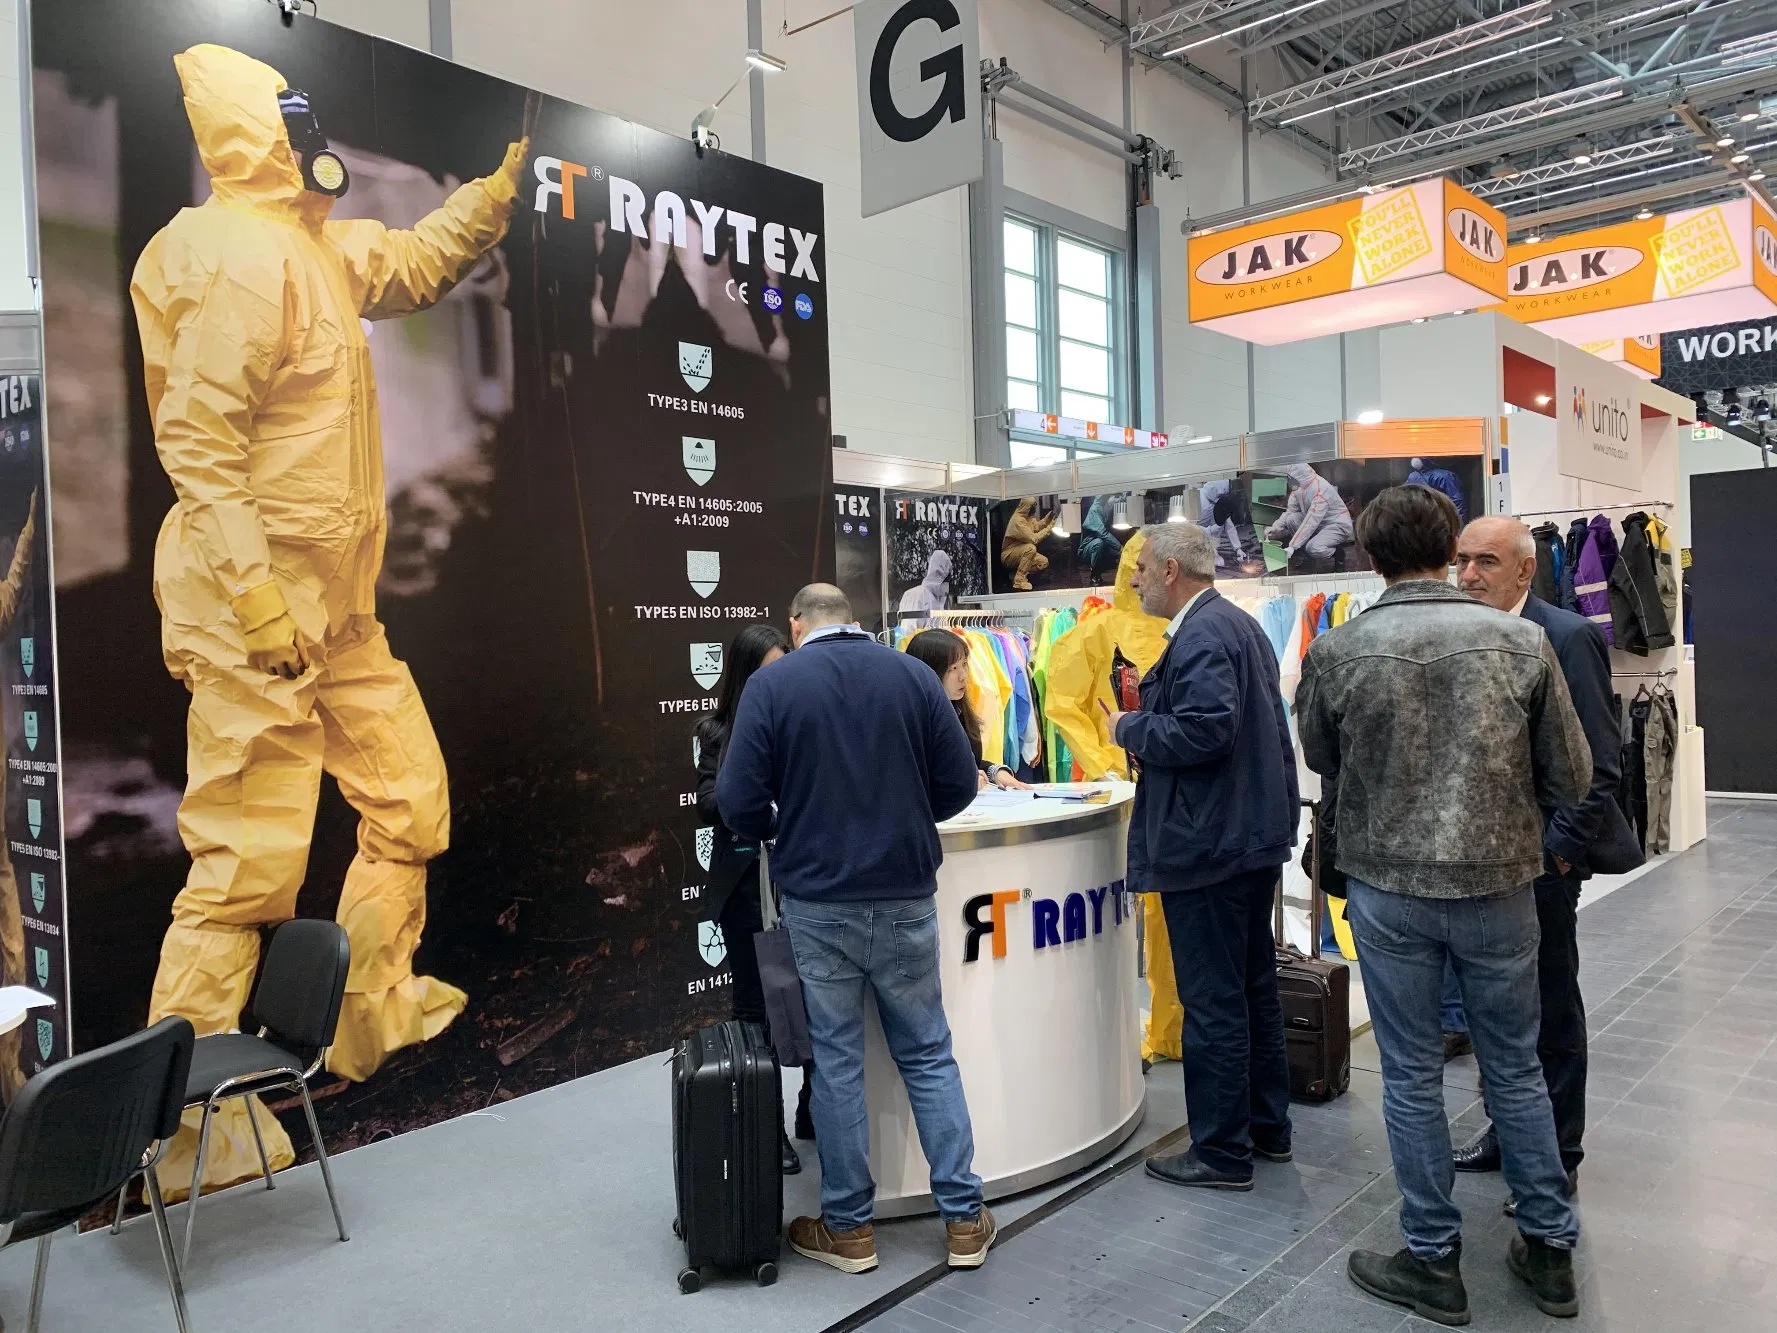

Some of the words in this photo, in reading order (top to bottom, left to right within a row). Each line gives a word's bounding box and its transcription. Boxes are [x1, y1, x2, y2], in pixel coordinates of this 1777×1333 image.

[870, 0, 966, 143] G
[1351, 197, 1412, 233] YOU'LL
[609, 175, 820, 283] RAYTEX
[1360, 211, 1415, 248] NEVER
[1653, 216, 1717, 248] YOU'LL
[1364, 225, 1420, 261] WORK
[1663, 229, 1721, 260] NEVER
[1371, 239, 1425, 276] ALONE
[1667, 243, 1726, 275] WORK
[1675, 255, 1733, 289] ALONE
[725, 279, 749, 305] CE
[763, 291, 782, 307] ISO
[1225, 275, 1313, 300] WORKWEAR
[1515, 288, 1612, 311] WORKWEAR
[648, 393, 688, 411] TYPE3
[691, 400, 708, 414] EN
[711, 404, 745, 419] 14605
[1591, 397, 1629, 442] unito
[633, 491, 675, 508] TYPE4
[678, 495, 696, 509] EN
[698, 498, 763, 513] 14605:2005
[835, 494, 870, 517] TEX
[915, 501, 978, 526] RAYTEX
[674, 513, 730, 527] +A1:2009
[635, 605, 676, 619] TYPE5
[680, 606, 696, 618] EN
[699, 606, 721, 618] ISO
[723, 606, 770, 618] 13982-1
[12, 684, 26, 695] TYPE3
[27, 685, 33, 695] EN
[659, 699, 699, 714] TYPE6
[701, 697, 719, 711] EN
[8, 758, 23, 770] TYPE4
[23, 760, 31, 771] EN
[679, 792, 697, 806] EN
[26, 844, 33, 855] EN
[33, 846, 42, 857] ISO
[682, 885, 700, 901] EN
[37, 919, 44, 932] EN
[688, 978, 706, 995] EN
